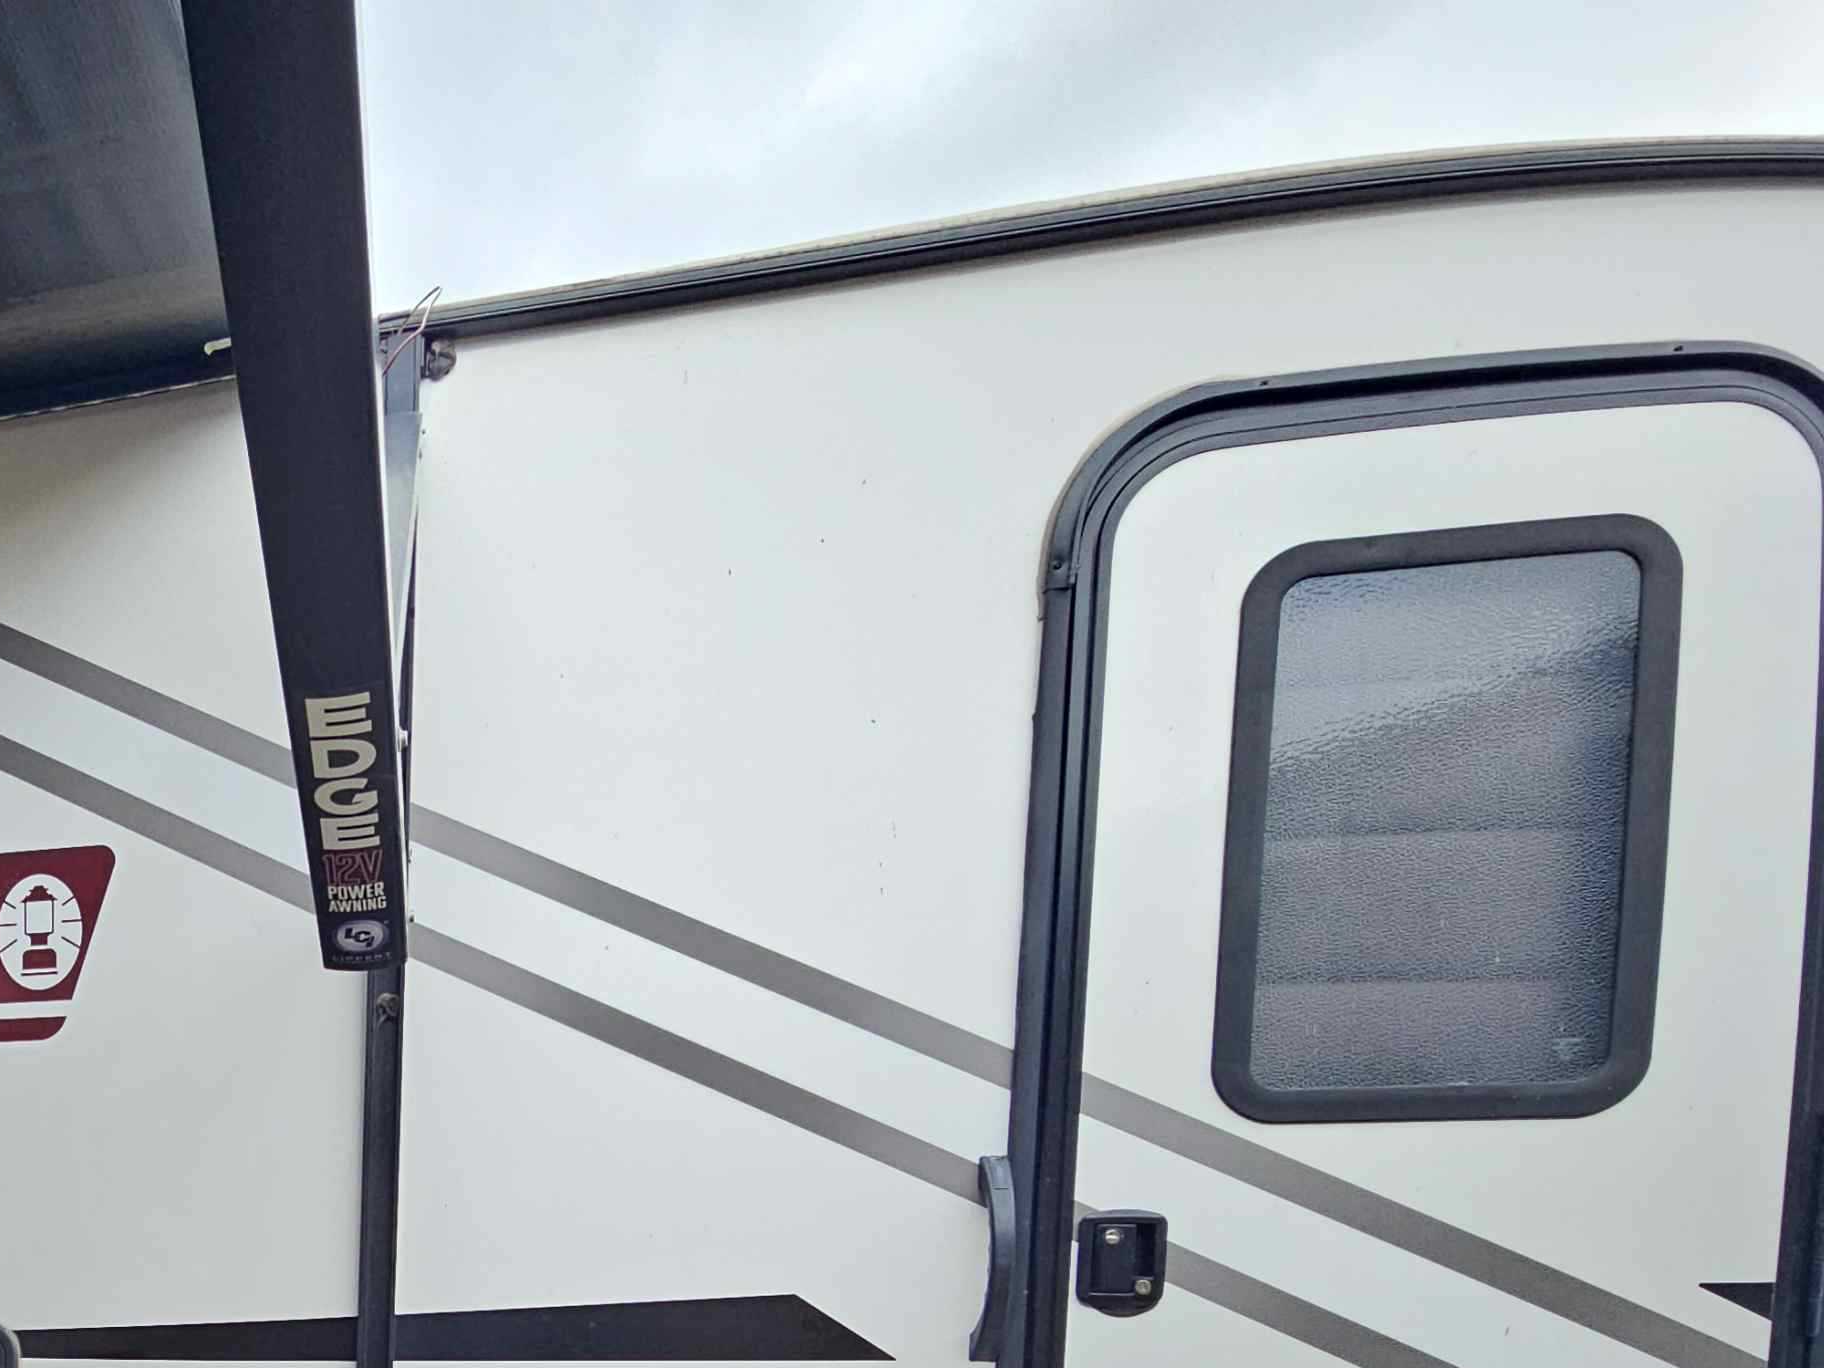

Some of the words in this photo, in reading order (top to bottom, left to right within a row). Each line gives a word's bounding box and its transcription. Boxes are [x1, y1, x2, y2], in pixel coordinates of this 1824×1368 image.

[304, 691, 380, 850] EDGE
[322, 850, 384, 885] 12V
[327, 881, 385, 900] POWER
[328, 895, 387, 913] AWNING
